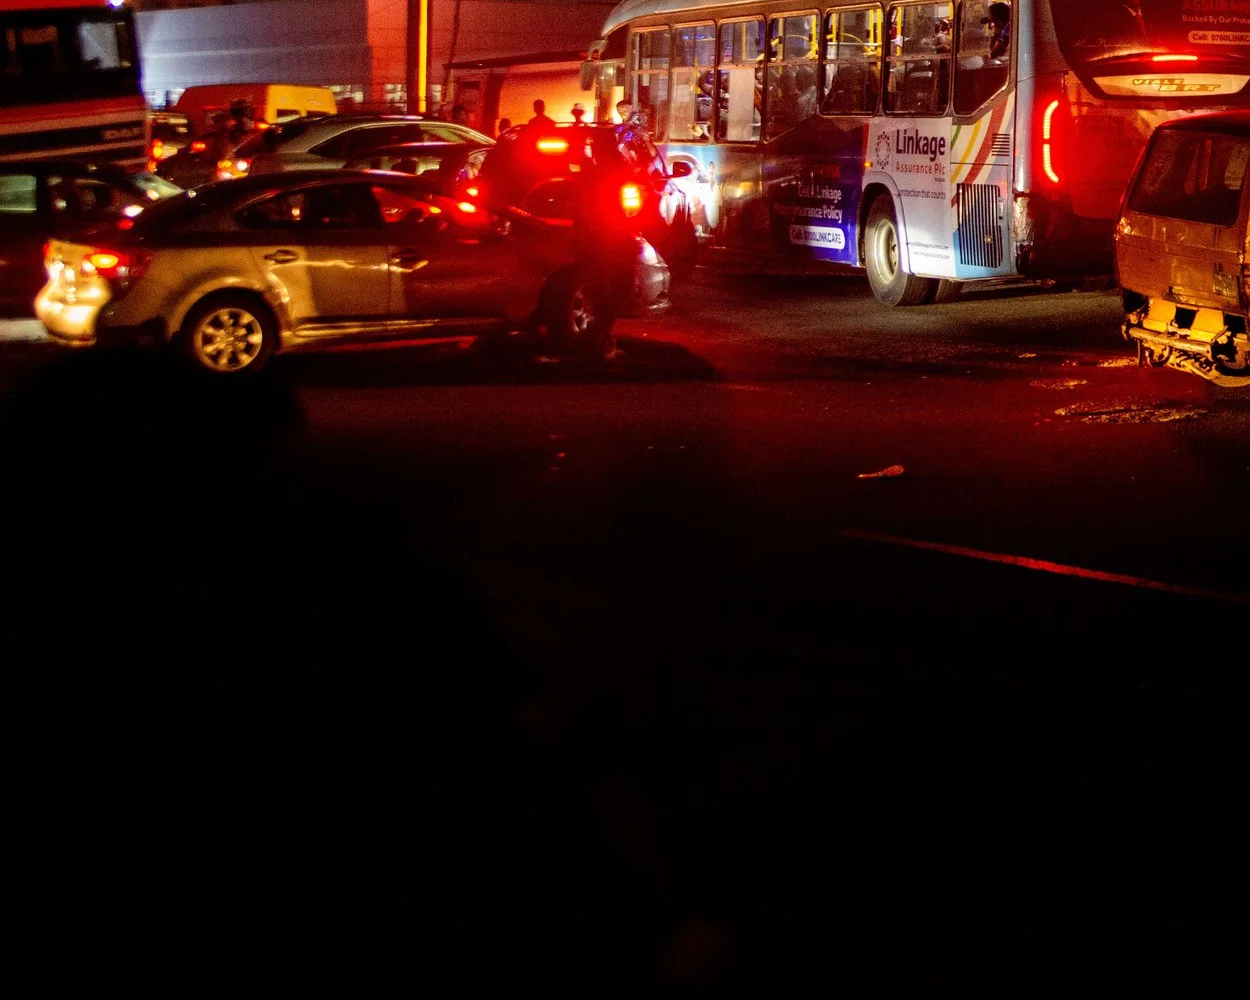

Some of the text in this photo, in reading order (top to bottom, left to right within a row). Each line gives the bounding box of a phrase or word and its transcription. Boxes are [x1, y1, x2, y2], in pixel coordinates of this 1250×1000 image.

[1182, 14, 1208, 23] Backed
[1209, 15, 1218, 24] By
[1192, 33, 1209, 41] Call:
[1158, 84, 1221, 92] BRT
[896, 129, 946, 162] Linkage
[896, 162, 946, 175] Assurance Plc
[816, 185, 842, 204] Linkage
[823, 205, 843, 224] Policy
